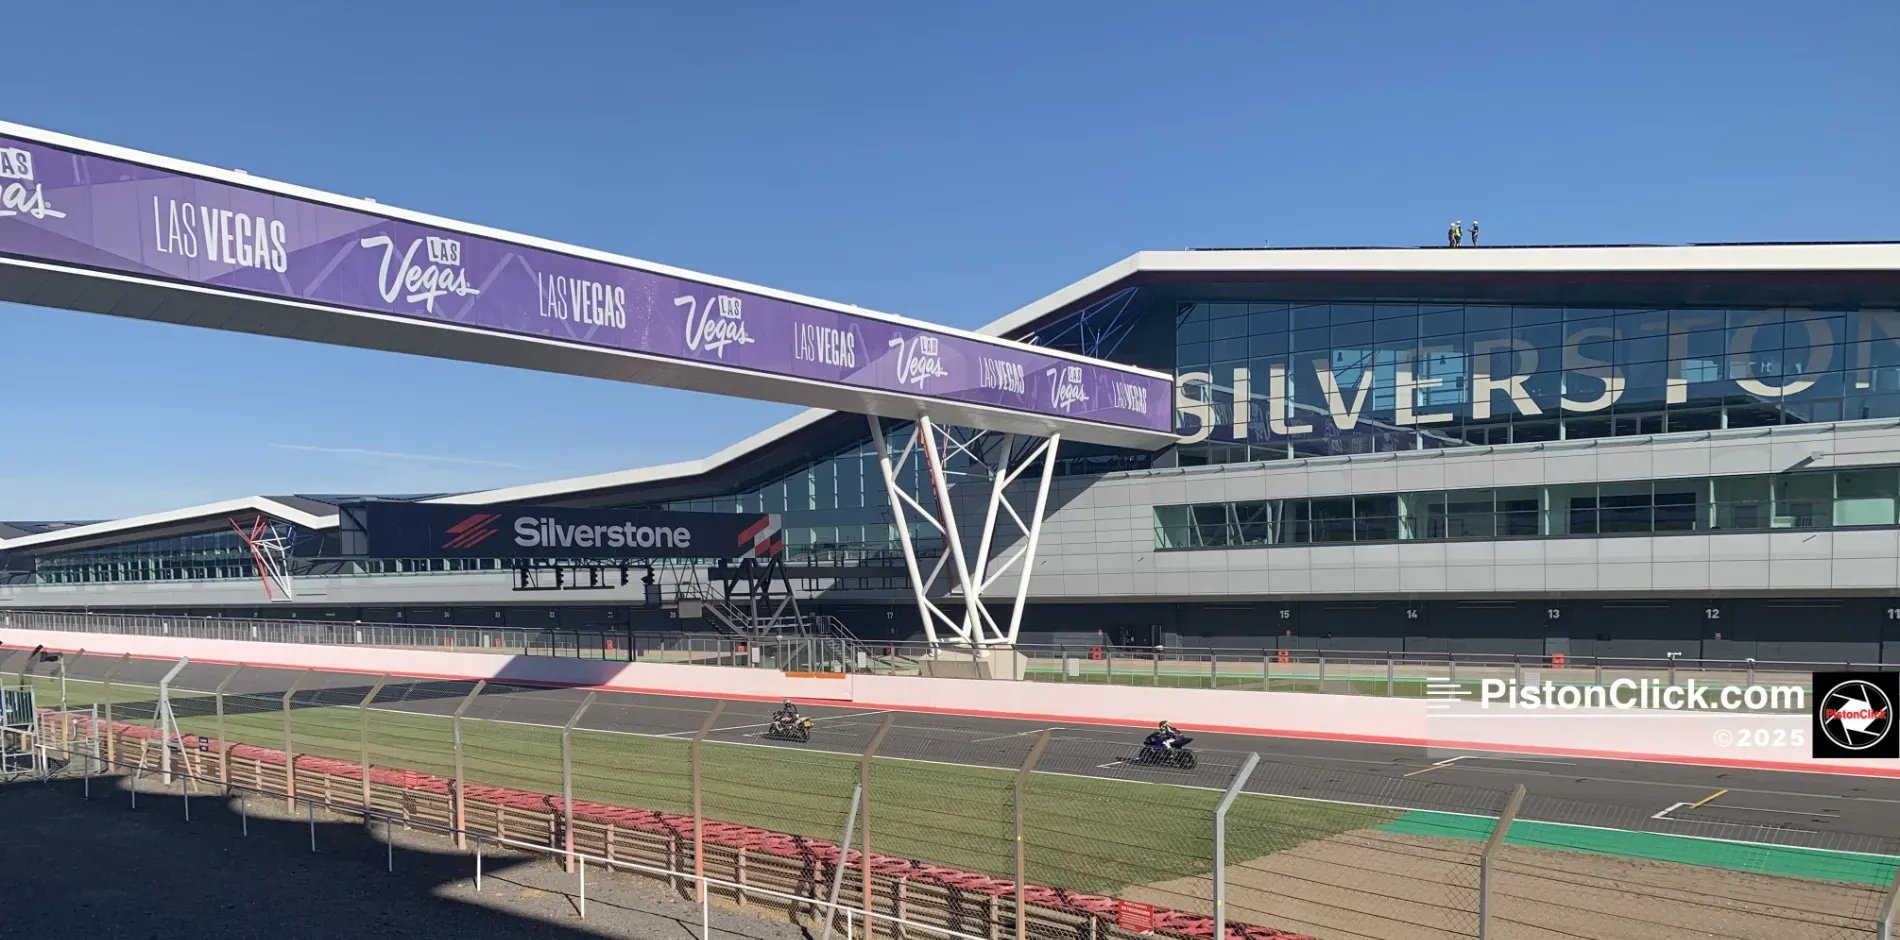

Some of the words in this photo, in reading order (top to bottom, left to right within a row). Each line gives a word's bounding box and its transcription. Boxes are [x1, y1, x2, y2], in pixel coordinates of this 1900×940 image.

[0, 150, 30, 177] AS
[153, 195, 197, 259] LAS
[201, 205, 288, 273] VEGAS
[429, 238, 460, 264] LAS
[361, 235, 480, 313] Vegas
[538, 271, 568, 320] LAS
[570, 278, 626, 330] VEGAS
[719, 296, 741, 318] LAS
[674, 295, 755, 359] Vegas
[794, 321, 815, 362] LAS
[816, 325, 855, 369] VEGAS
[921, 336, 938, 356] LAS
[889, 337, 948, 390] Vegas
[979, 356, 996, 390] LAS
[997, 358, 1024, 395] VEGAS
[1068, 366, 1082, 384] LAS
[1047, 368, 1089, 412] Vegas
[1111, 379, 1125, 410] LAS
[1124, 382, 1147, 415] VEGAS
[514, 516, 691, 548] Silverstone
[886, 611, 894, 619] 17
[1279, 610, 1290, 619] 15
[1406, 609, 1418, 619] 14
[1548, 609, 1560, 619] 13
[1705, 608, 1720, 619] 12
